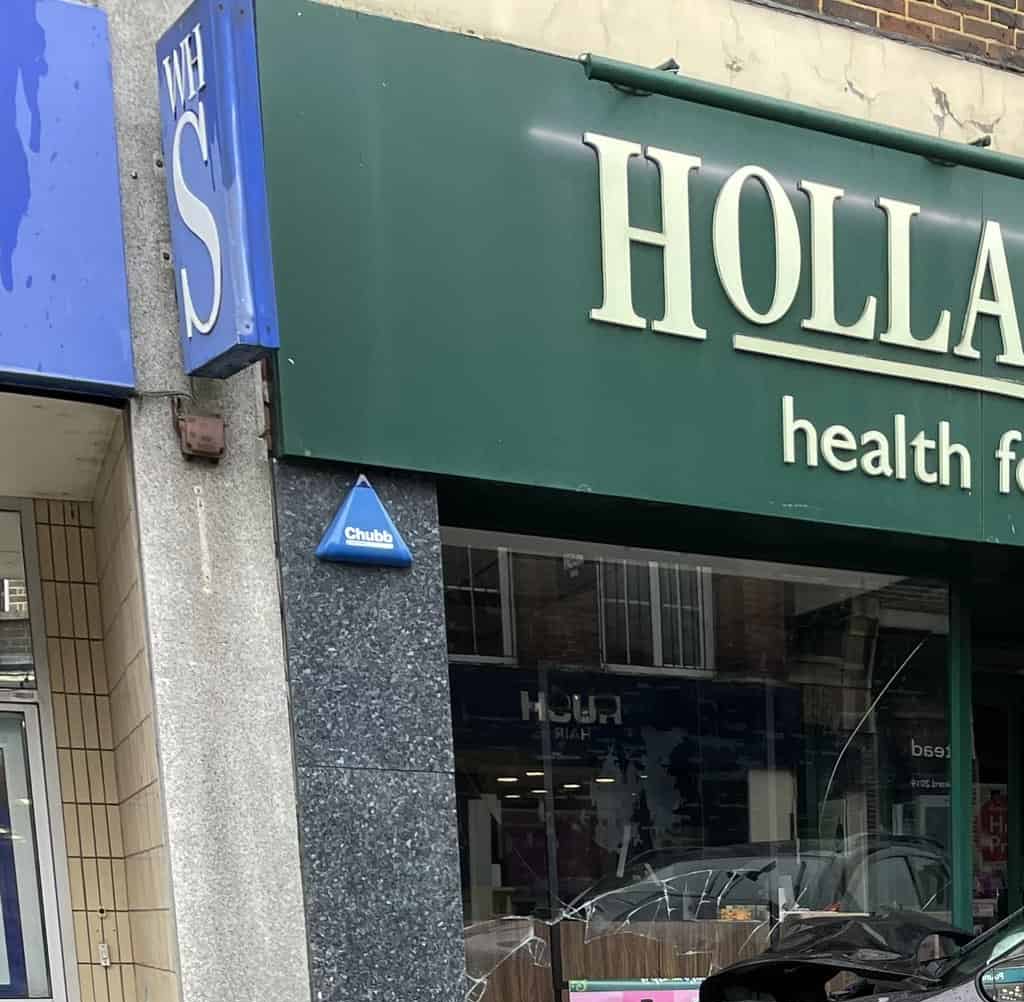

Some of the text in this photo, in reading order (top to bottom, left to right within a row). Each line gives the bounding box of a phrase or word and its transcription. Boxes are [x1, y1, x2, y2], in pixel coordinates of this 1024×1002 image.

[162, 23, 206, 115] WH
[172, 101, 222, 338] S
[782, 395, 971, 489] health
[344, 526, 393, 543] Chubb
